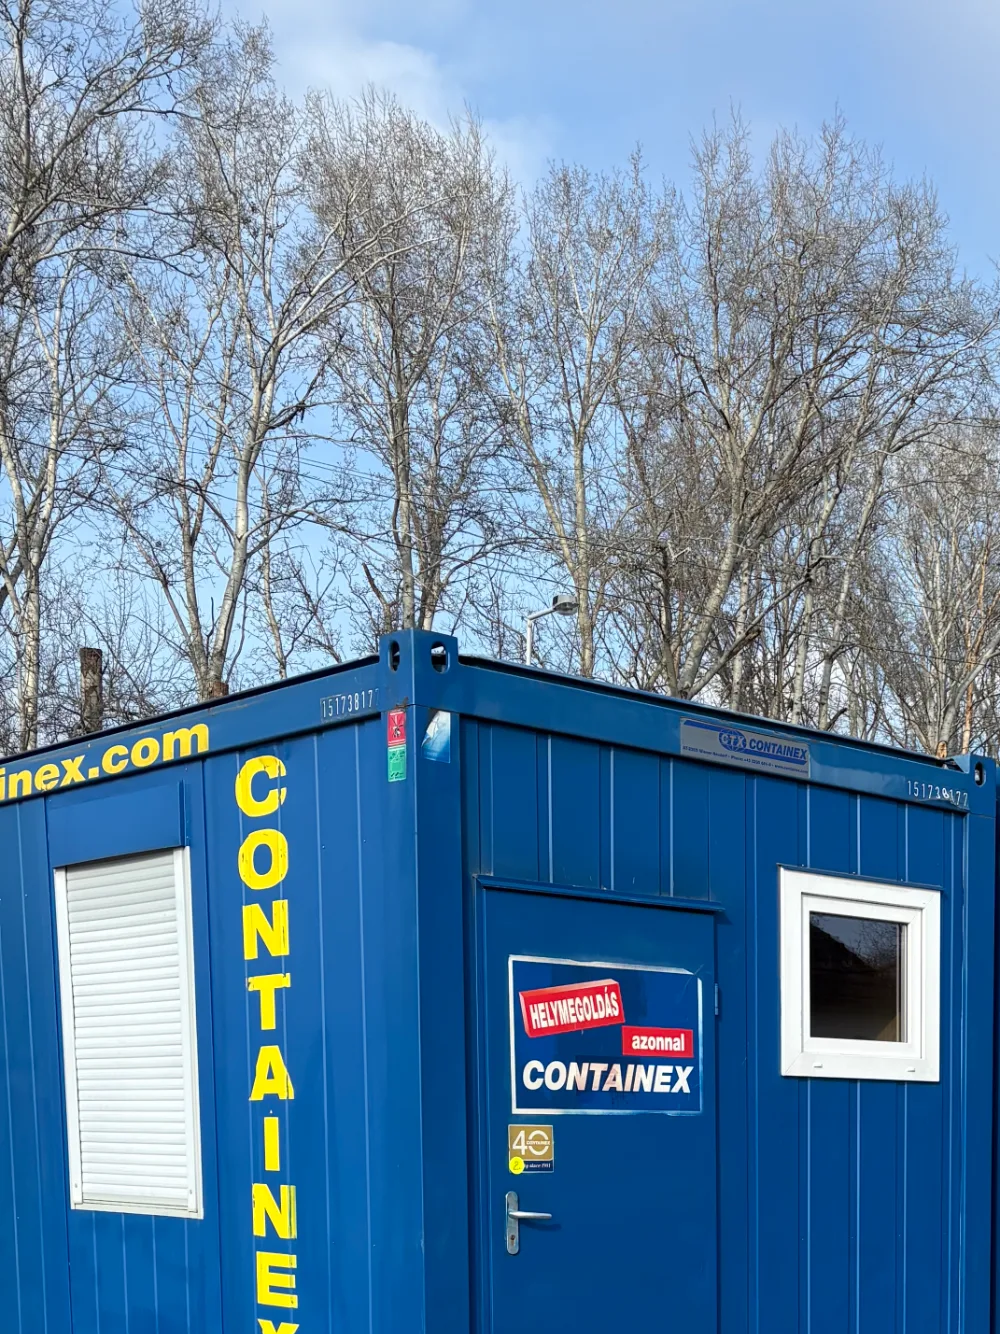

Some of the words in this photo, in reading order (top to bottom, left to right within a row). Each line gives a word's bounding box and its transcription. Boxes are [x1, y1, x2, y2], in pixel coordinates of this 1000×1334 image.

[322, 688, 379, 718] 151738177
[721, 733, 746, 748] CTX
[749, 738, 808, 760] CONTAINEX
[907, 780, 969, 807] 151738177
[529, 986, 619, 1030] HELYMEGOLDÁS
[632, 1033, 685, 1051] azonnal
[522, 1060, 694, 1093] CONTAINEX
[512, 1129, 550, 1156] 40
